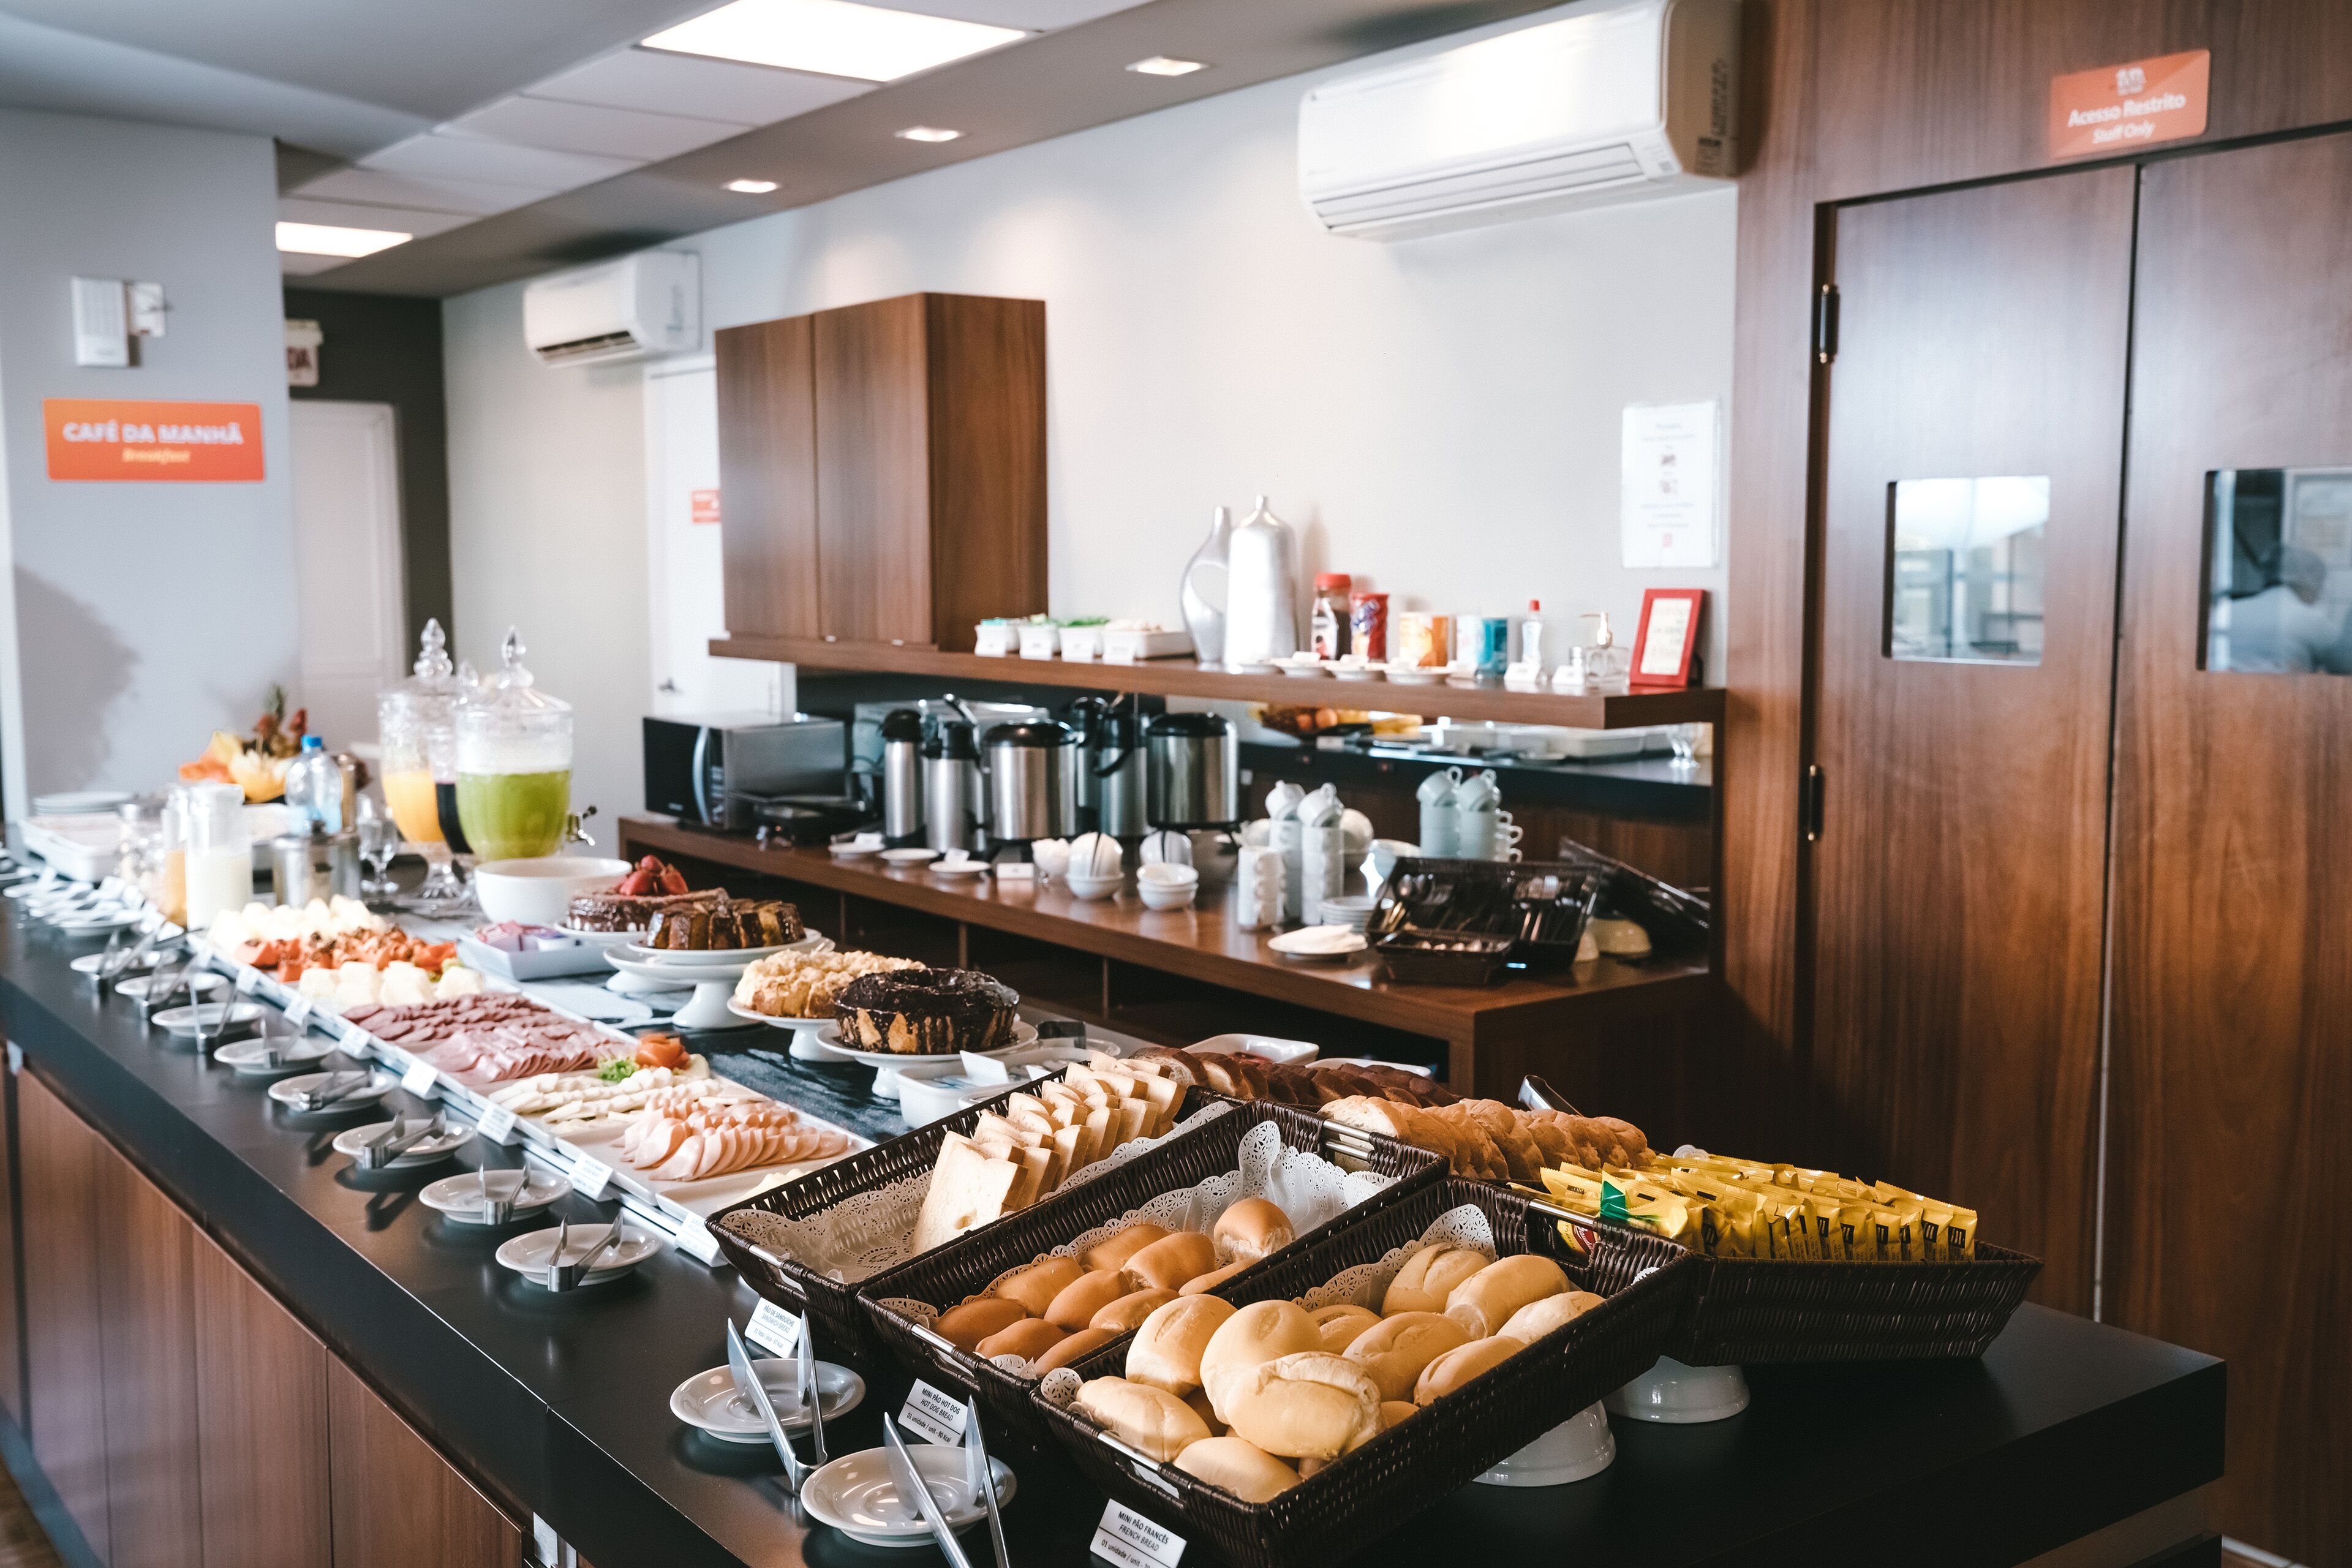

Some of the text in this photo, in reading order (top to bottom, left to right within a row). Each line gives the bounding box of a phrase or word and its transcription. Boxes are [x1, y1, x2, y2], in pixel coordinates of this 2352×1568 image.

[2068, 93, 2186, 127] Acesso Restrito
[2093, 120, 2155, 144] Staff Only
[63, 419, 244, 445] CAFÉ DA MANHÃ
[761, 1313, 790, 1333] SANDWICH BREAD
[922, 1388, 960, 1414] MINI PÃO HOT DOG
[929, 1403, 940, 1413] DOG
[939, 1409, 953, 1421] BREAD
[911, 1416, 926, 1428] unidade
[943, 1434, 952, 1443] Kcal
[1118, 1511, 1169, 1544] MINI PÃO FRANCÊS
[1118, 1525, 1159, 1551] FRENCH BREAD
[1107, 1544, 1127, 1558] unidade
[1130, 1558, 1140, 1567] unit
